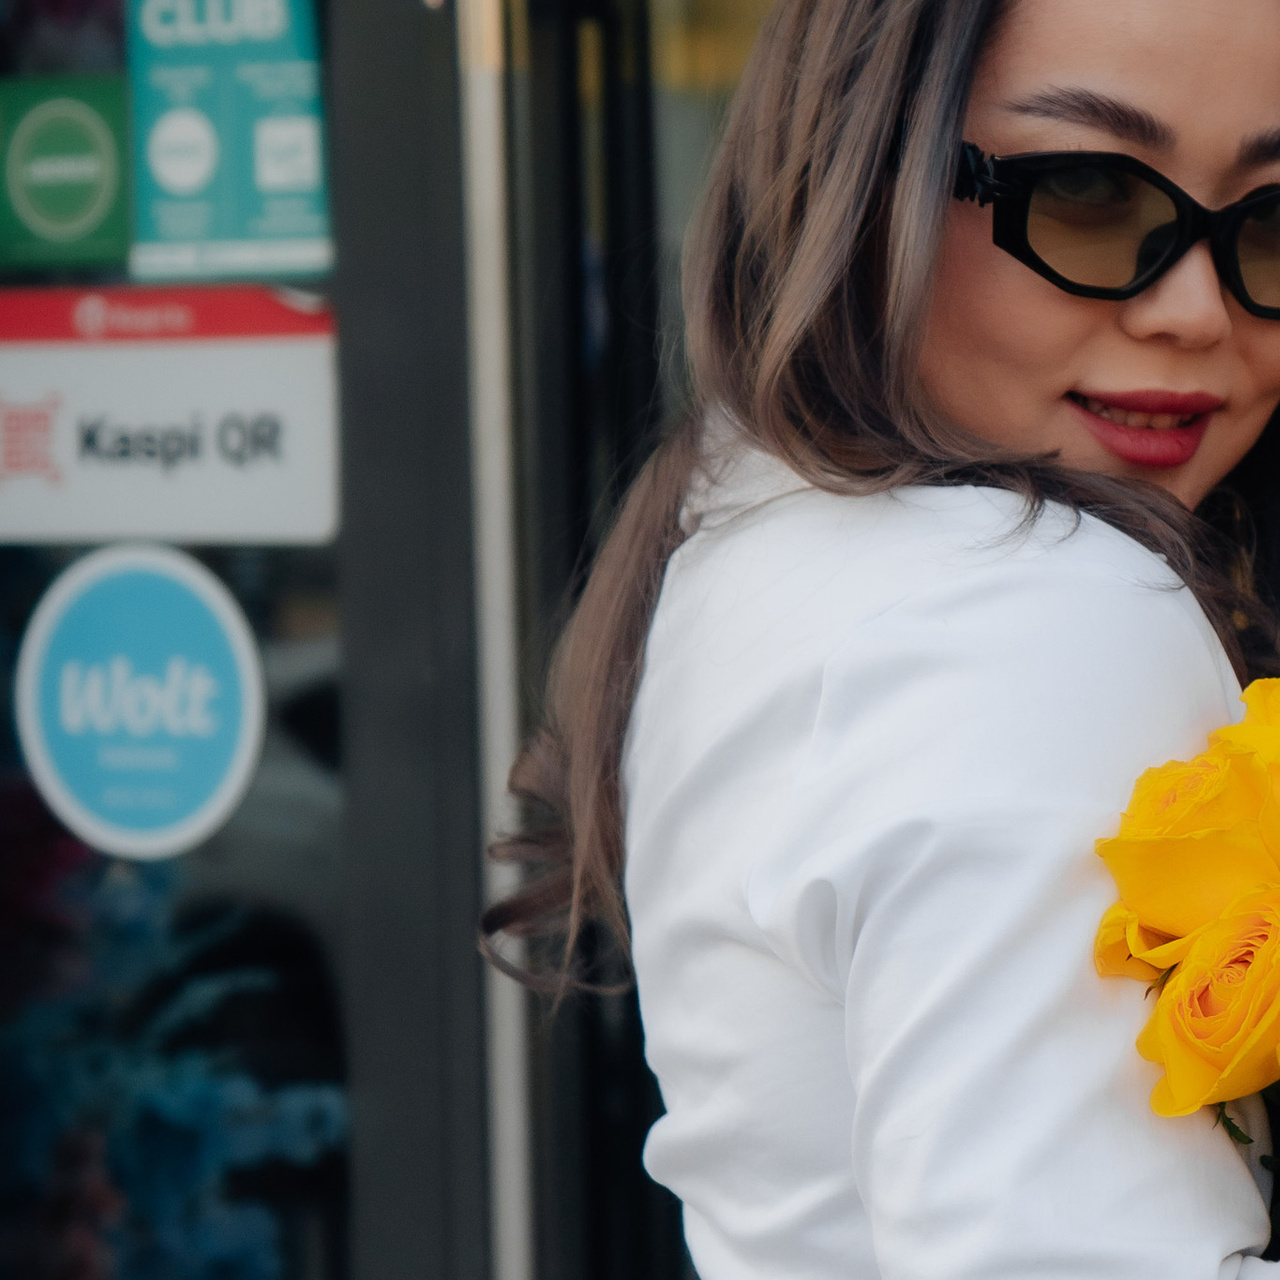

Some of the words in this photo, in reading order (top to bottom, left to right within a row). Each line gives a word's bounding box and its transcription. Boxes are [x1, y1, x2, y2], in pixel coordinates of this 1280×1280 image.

[79, 414, 203, 475] Kaspi
[216, 414, 283, 469] QR
[60, 656, 218, 738] Wolt
